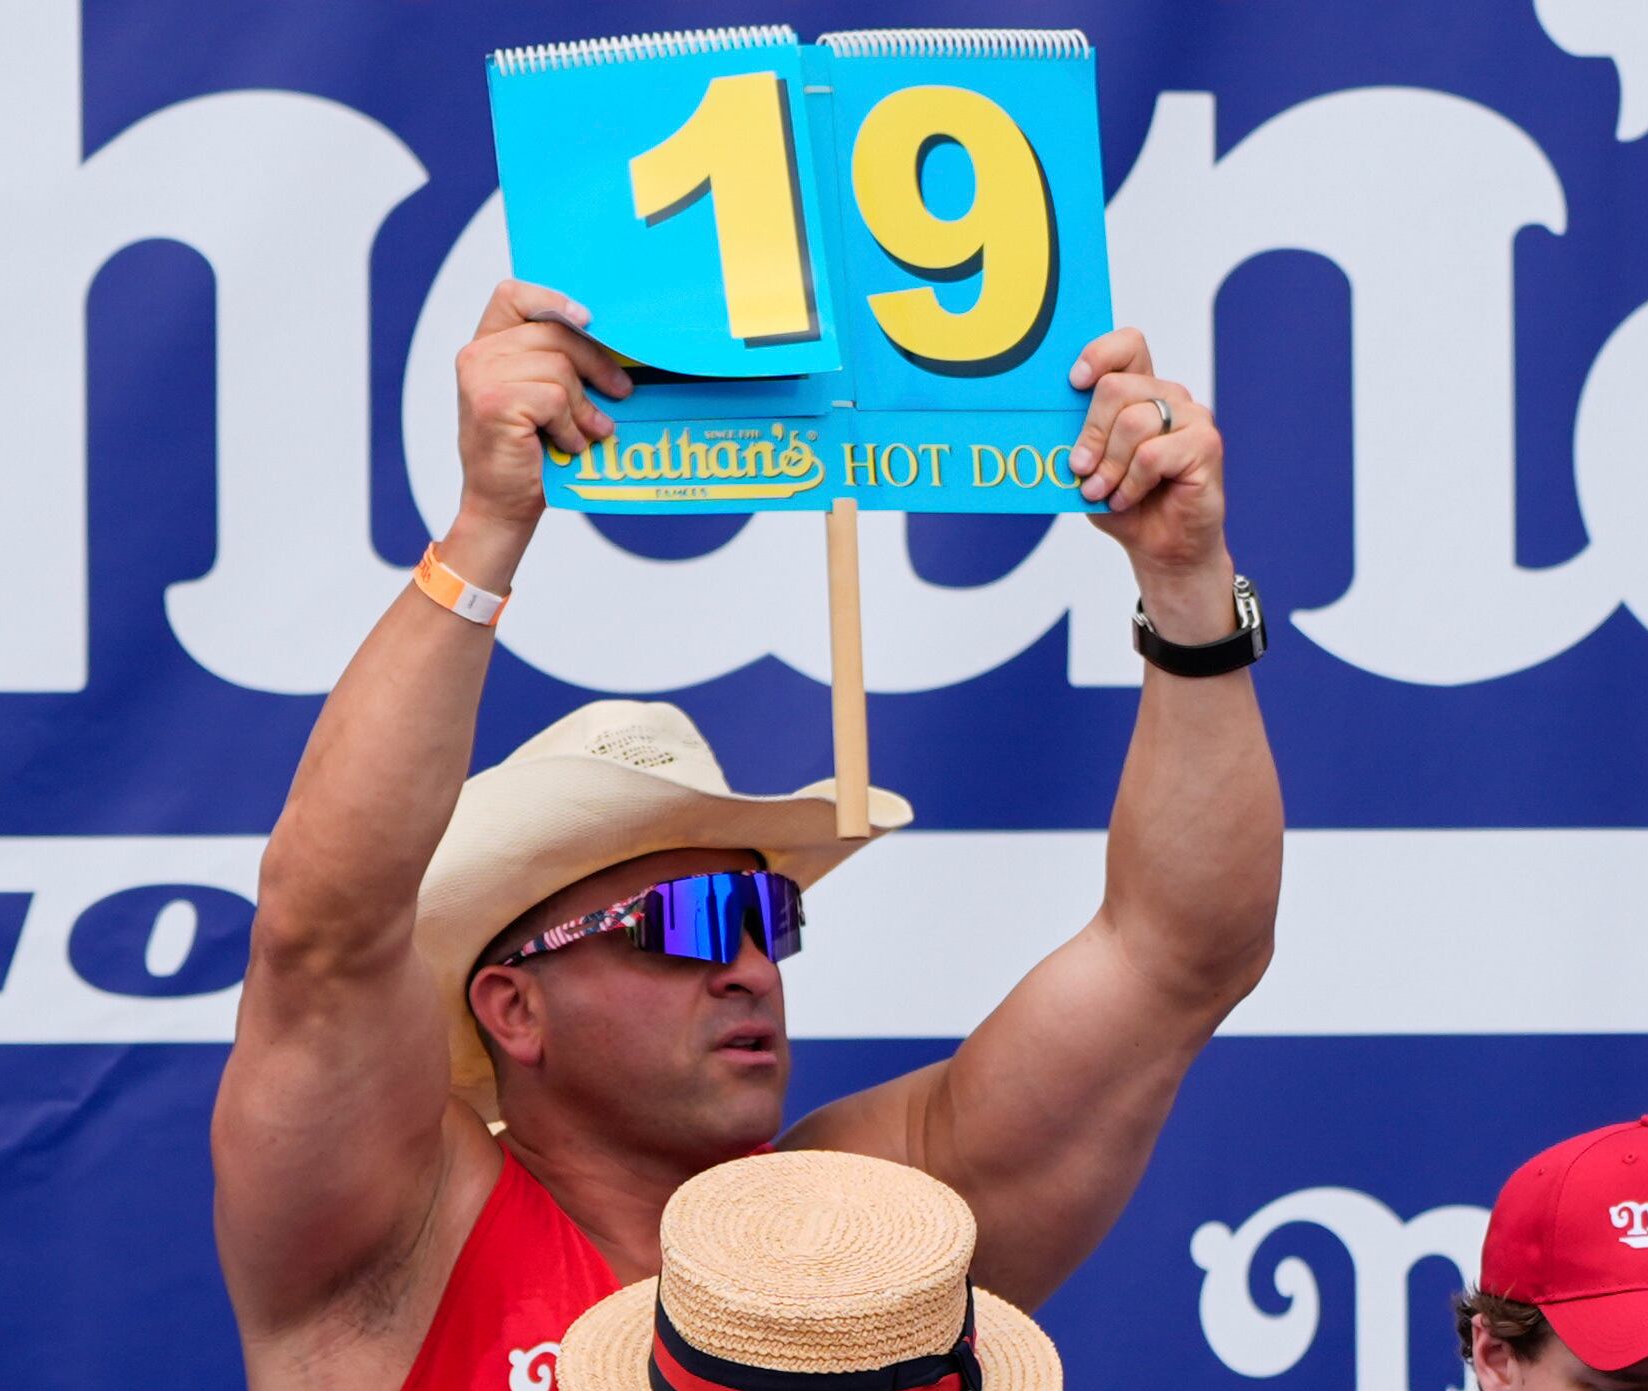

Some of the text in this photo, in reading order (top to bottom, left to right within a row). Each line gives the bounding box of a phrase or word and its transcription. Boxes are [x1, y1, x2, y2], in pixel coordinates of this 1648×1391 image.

[630, 71, 1057, 375] 19
[842, 443, 950, 487] HOT
[970, 444, 1082, 489] DOG
